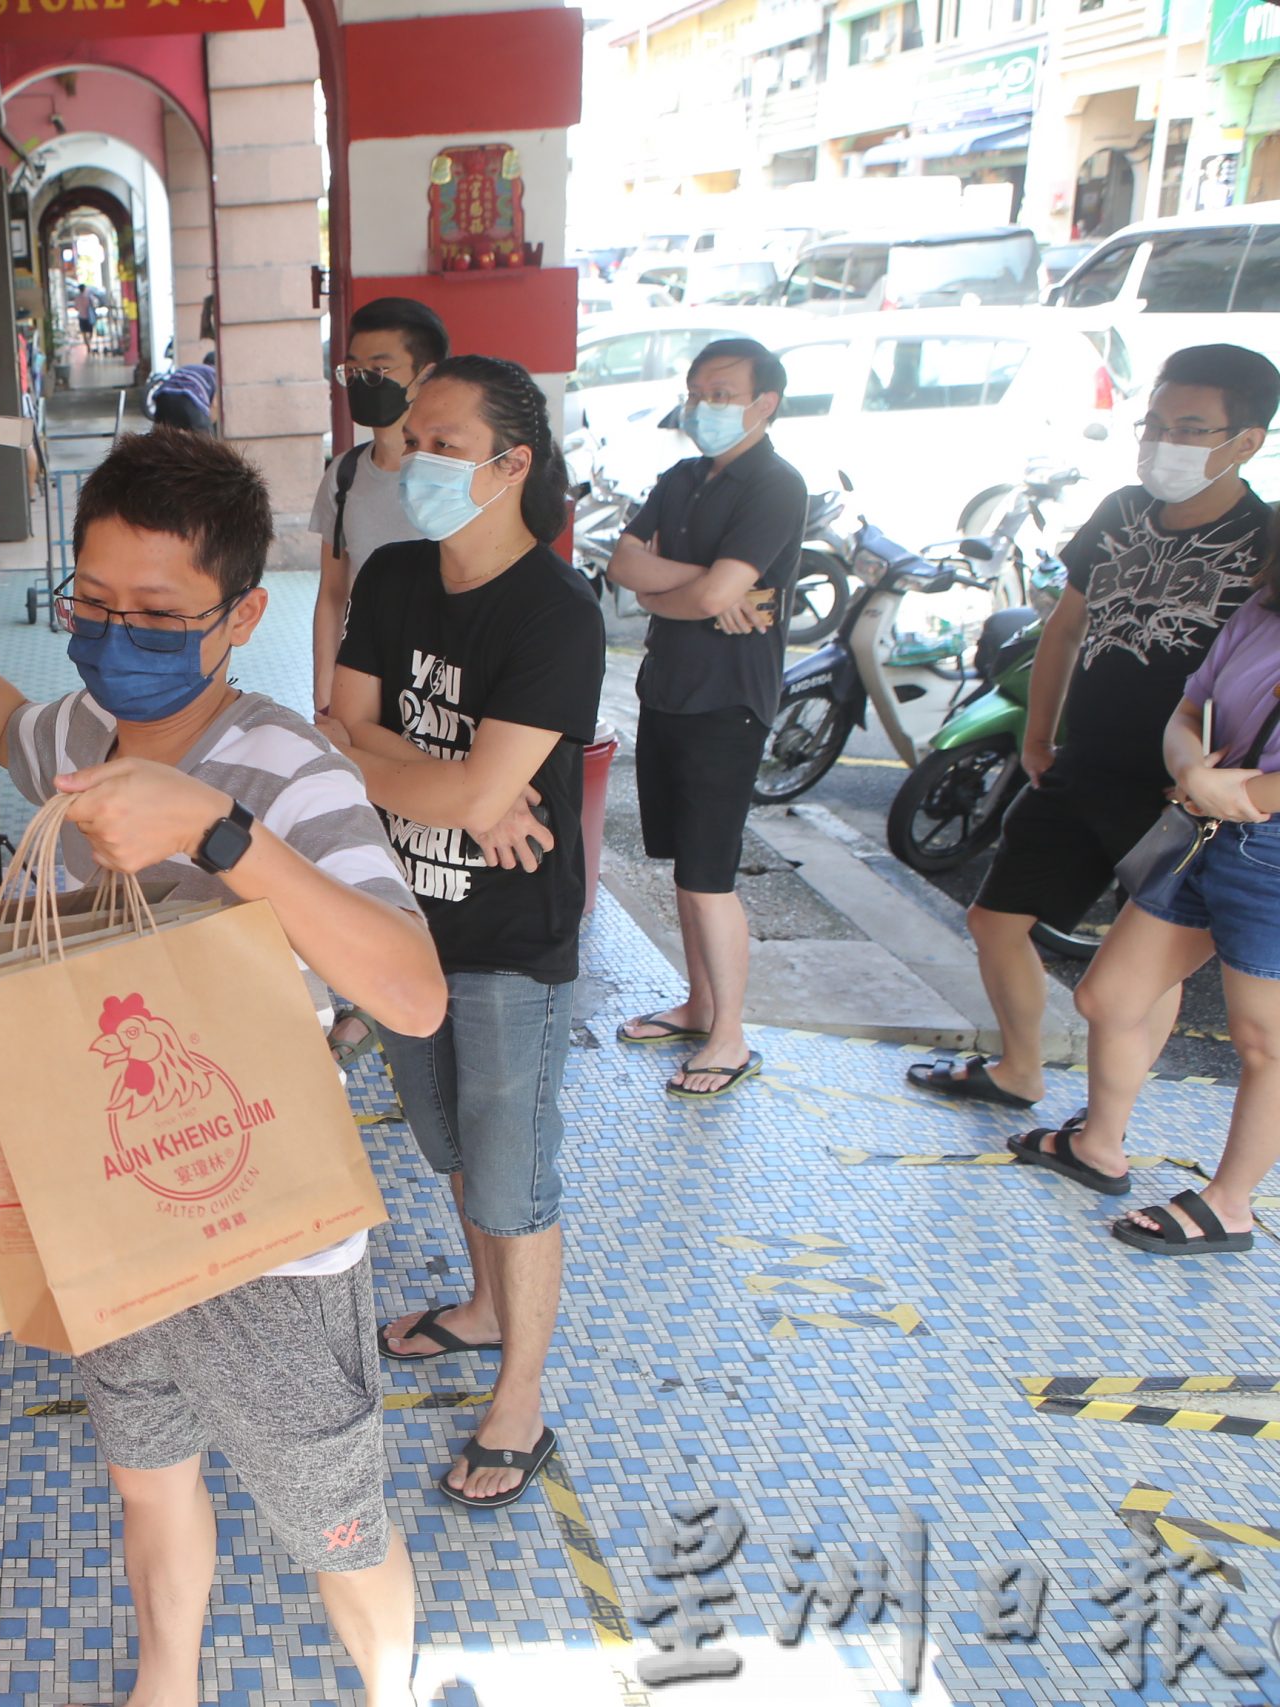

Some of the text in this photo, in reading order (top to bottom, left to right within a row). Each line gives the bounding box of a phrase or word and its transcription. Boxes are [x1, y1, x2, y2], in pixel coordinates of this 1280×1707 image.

[411, 648, 462, 706] YOU
[391, 846, 472, 902] LONE
[103, 1097, 277, 1182] AUN KHENG LIM
[154, 1165, 261, 1219] SALTED CHICKEN
